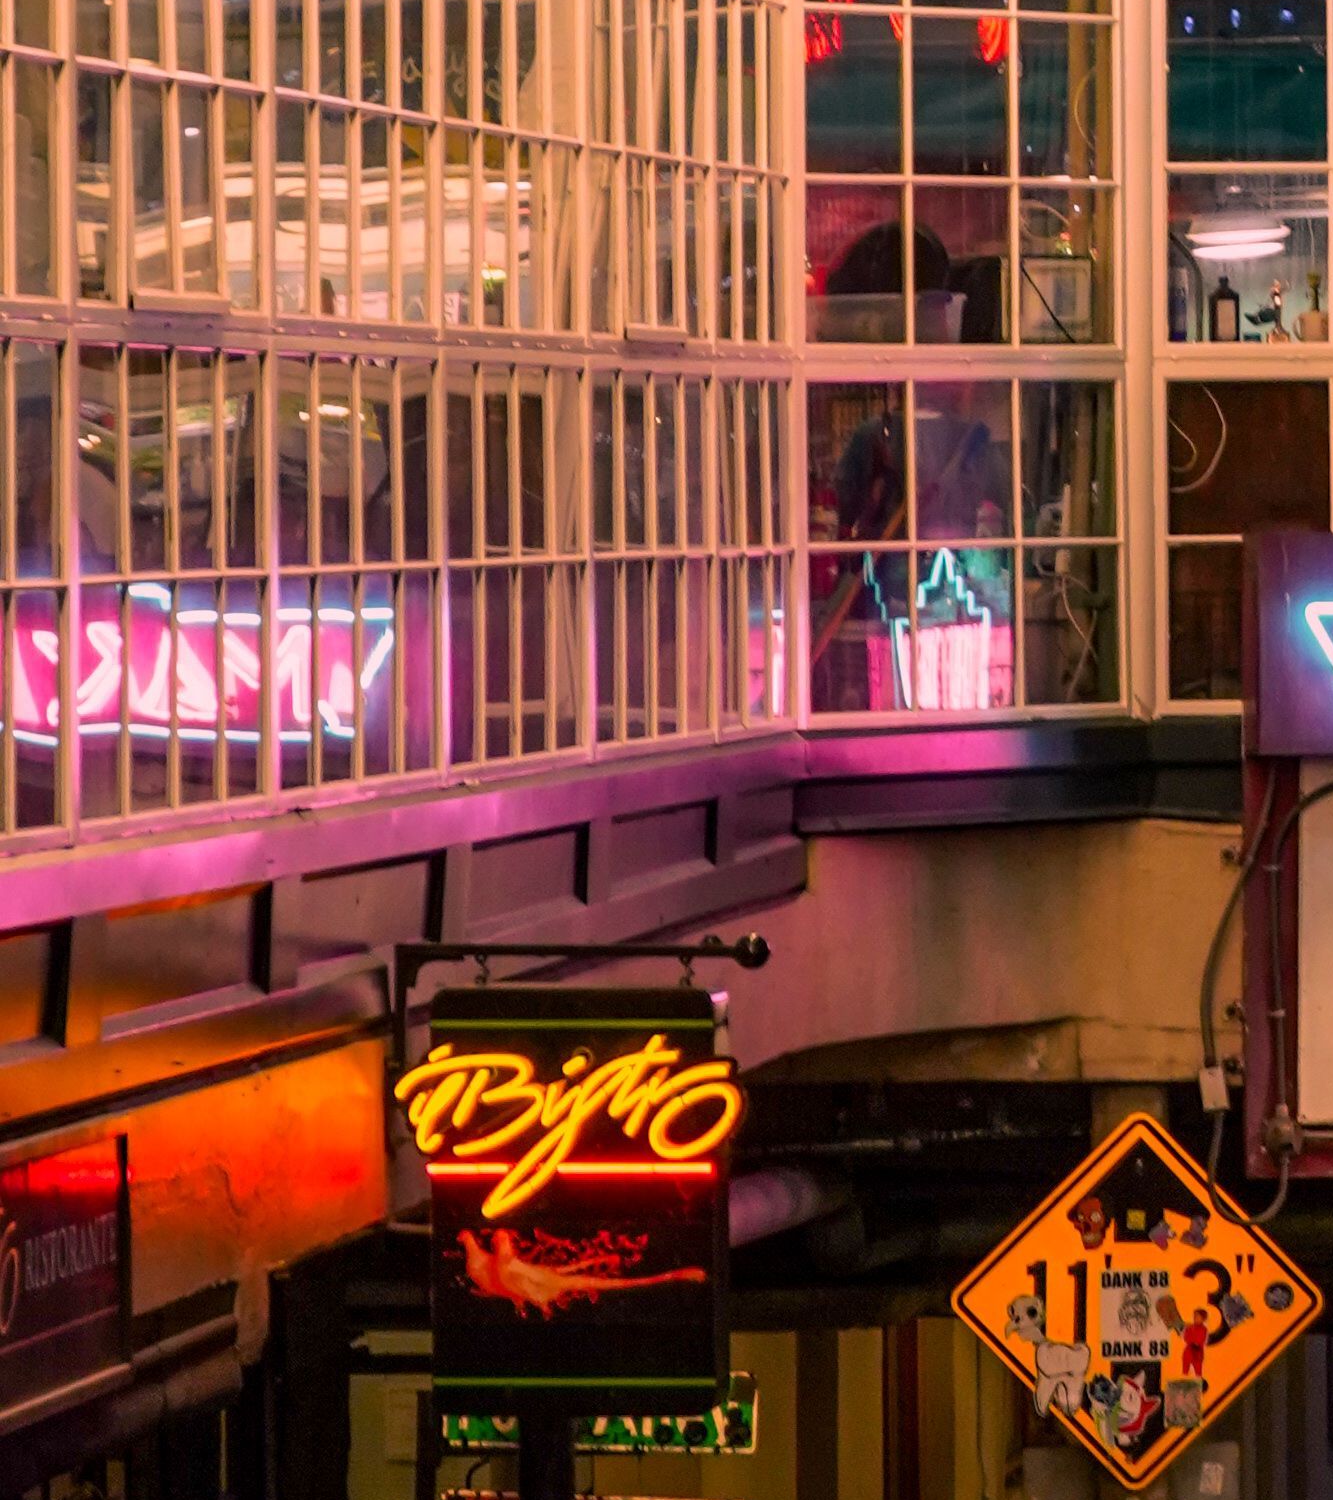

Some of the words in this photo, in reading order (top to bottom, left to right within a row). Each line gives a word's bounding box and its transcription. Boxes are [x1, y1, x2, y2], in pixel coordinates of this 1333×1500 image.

[1100, 1270, 1143, 1290] DANK
[1147, 1270, 1170, 1289] 88
[1100, 1340, 1143, 1358] DANK
[1147, 1339, 1170, 1358] 88
